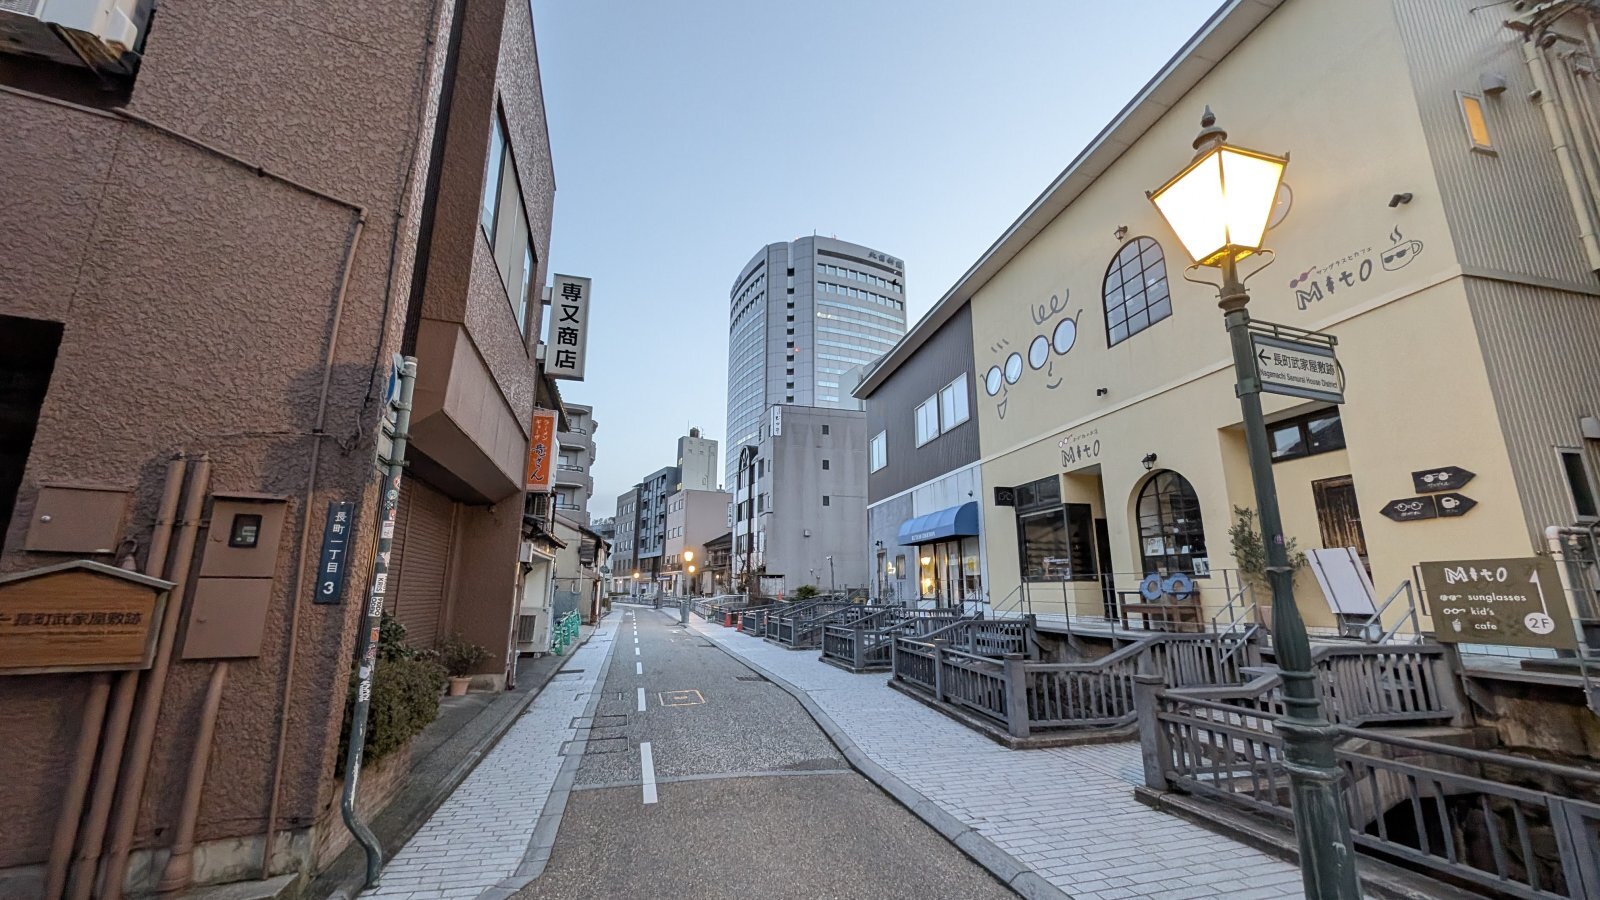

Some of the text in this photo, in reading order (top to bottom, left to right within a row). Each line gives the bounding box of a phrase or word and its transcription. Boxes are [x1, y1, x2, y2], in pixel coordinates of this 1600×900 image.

[555, 282, 582, 370] 専又商店
[1273, 352, 1335, 376] 長町武家屋敷跡
[1260, 368, 1338, 388] Nagamachi Samurai House District
[326, 511, 346, 573] 長町一丁目
[1467, 592, 1527, 603] sunglasses
[1470, 606, 1495, 616] kid's
[14, 612, 143, 626] 長町武家屋敷跡
[1474, 621, 1498, 631] cafe
[1528, 617, 1550, 630] 2F
